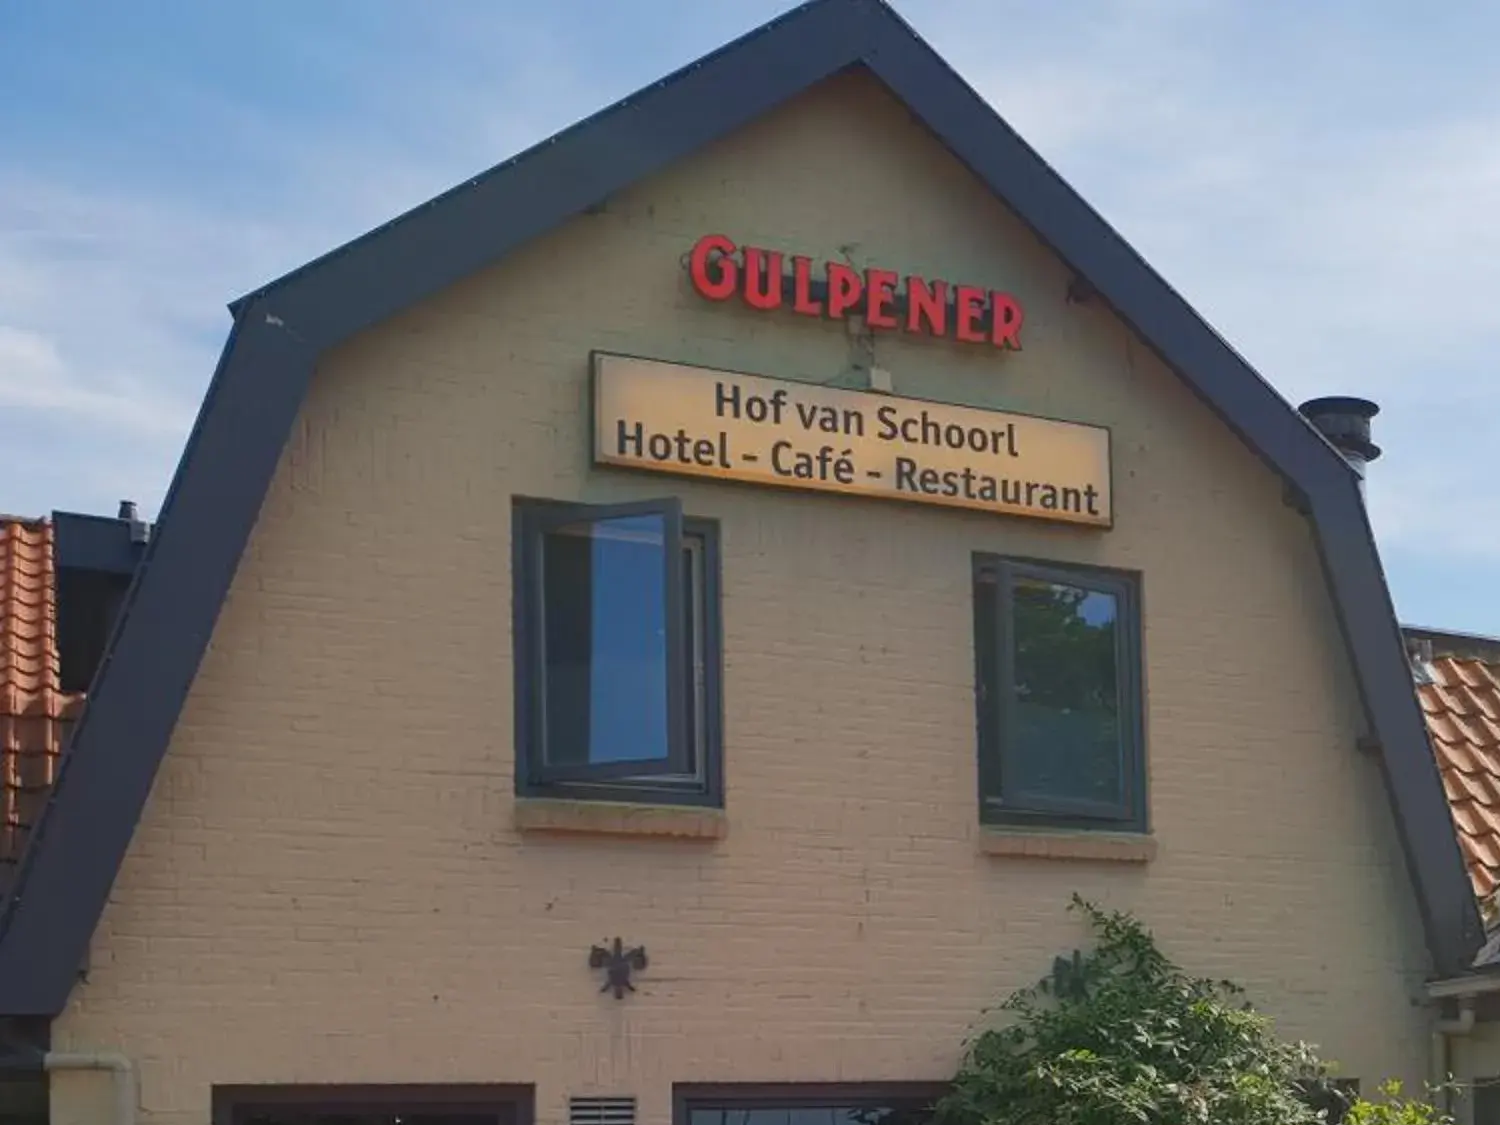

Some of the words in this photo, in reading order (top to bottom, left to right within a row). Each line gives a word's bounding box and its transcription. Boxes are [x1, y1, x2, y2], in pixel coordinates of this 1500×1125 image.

[690, 234, 1024, 350] GULPENER
[617, 419, 733, 470] Hotel
[770, 440, 855, 485] Café
[895, 456, 1100, 517] Restaurant
[715, 381, 789, 425] Hof
[795, 402, 864, 437] van
[876, 405, 1019, 458] Schoorl
